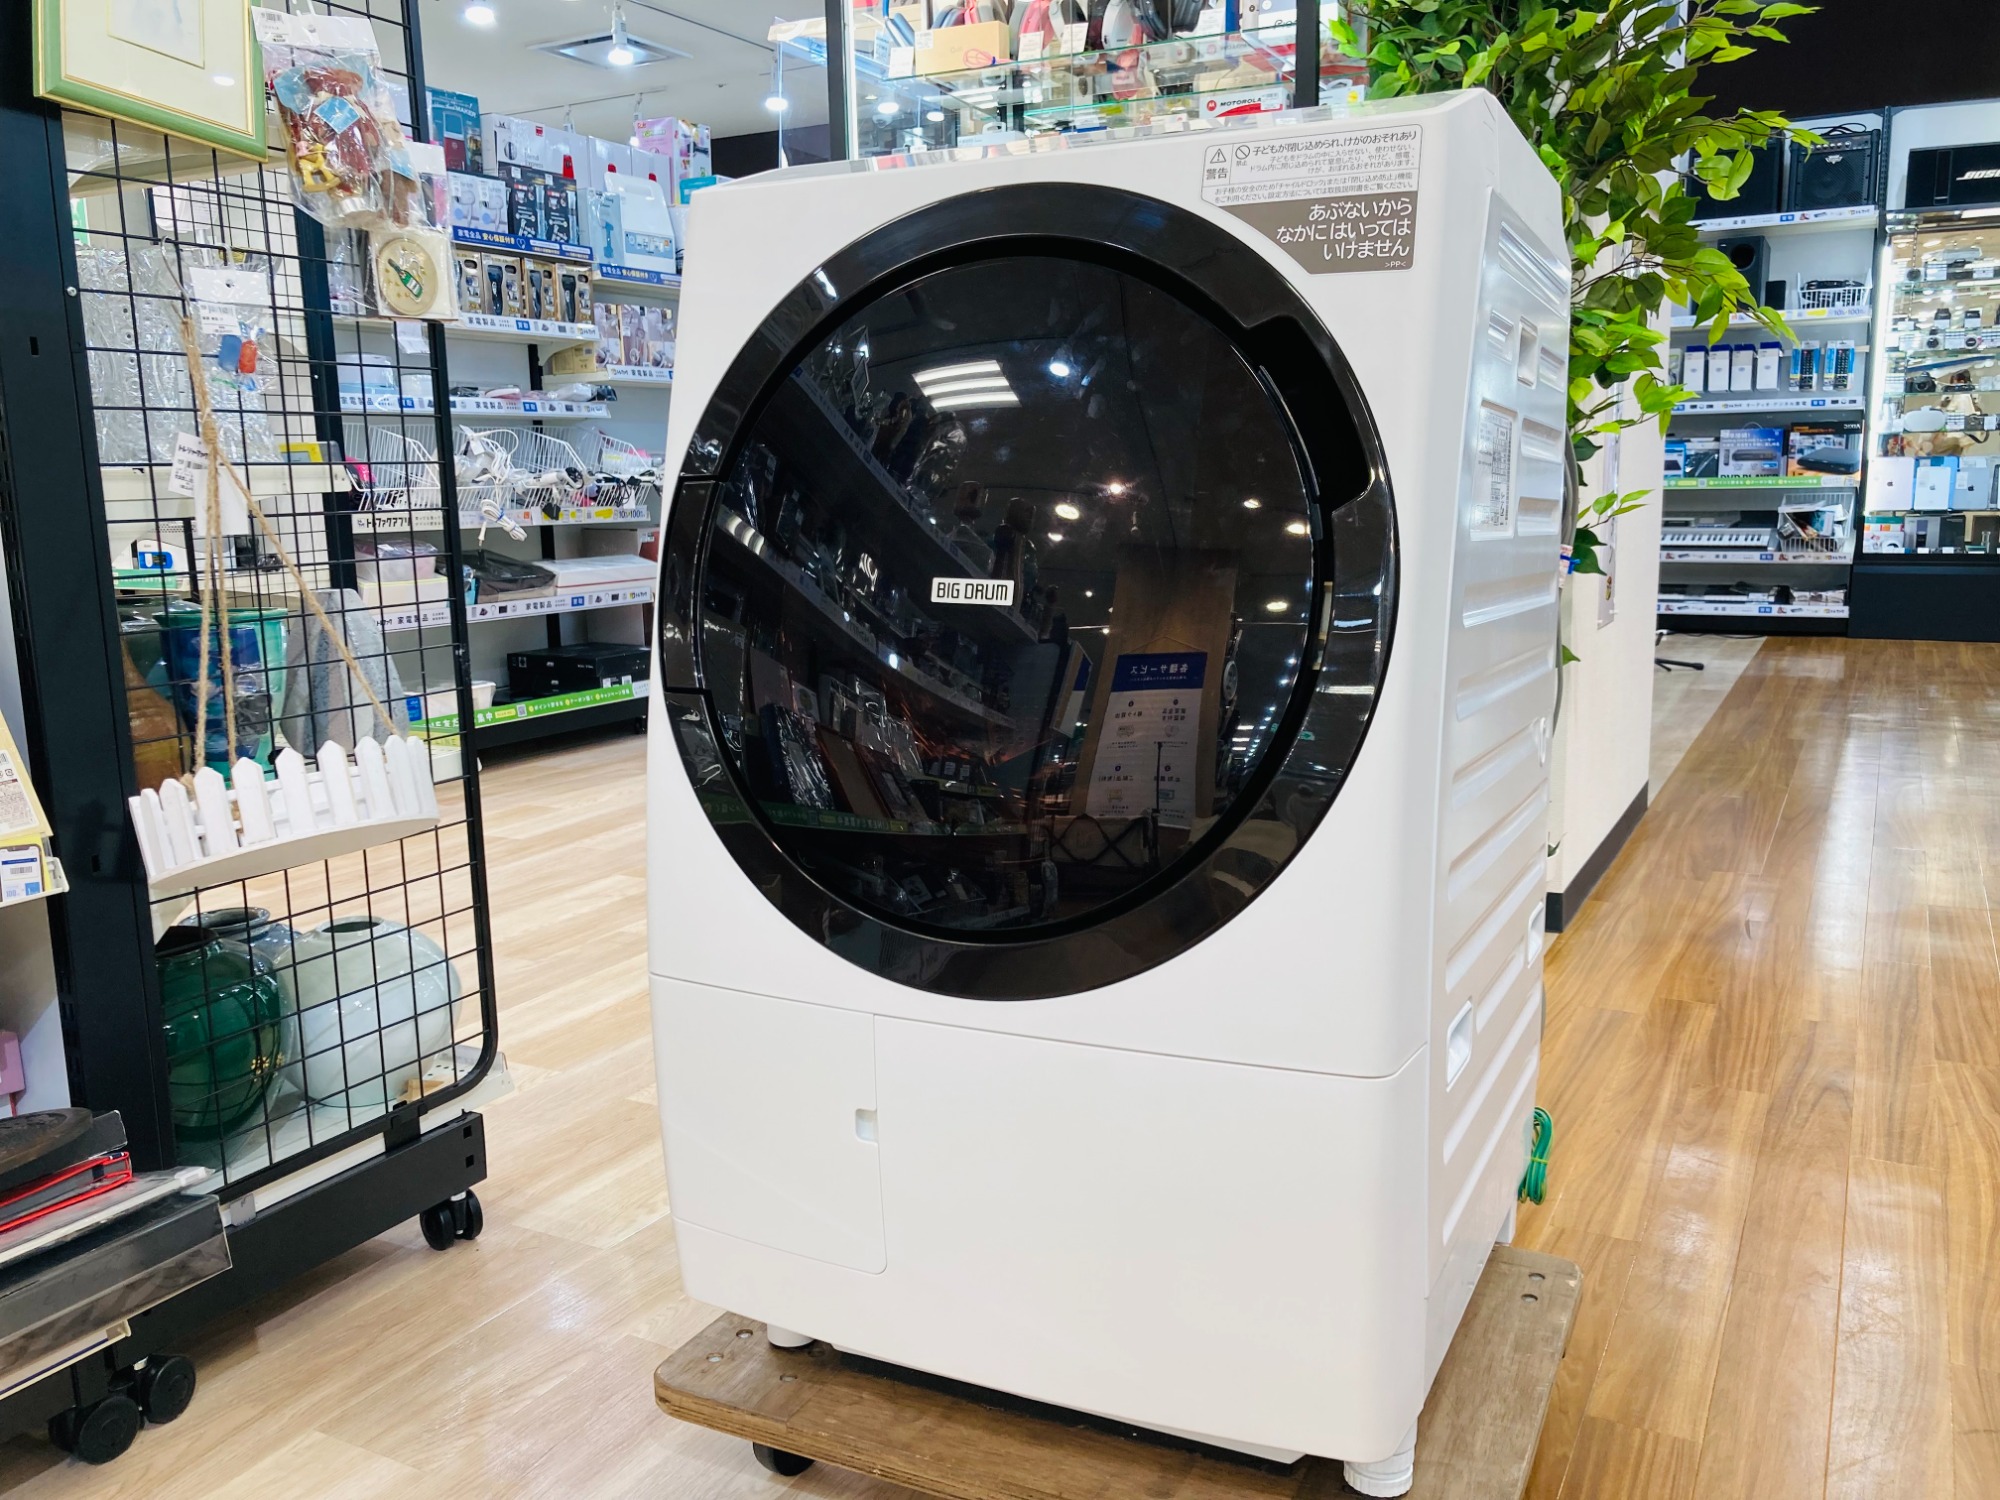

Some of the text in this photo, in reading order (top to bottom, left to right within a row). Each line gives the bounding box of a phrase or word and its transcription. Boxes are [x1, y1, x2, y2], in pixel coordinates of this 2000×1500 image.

[1220, 98, 1261, 107] MOTOROLA
[1252, 130, 1417, 156] 子どもが閉じ込められ、けがのおそれあり
[1206, 167, 1229, 180] 警告
[1309, 197, 1412, 221] あぶないから
[1323, 239, 1410, 260] いけません
[937, 582, 1008, 600] BIG DRUM
